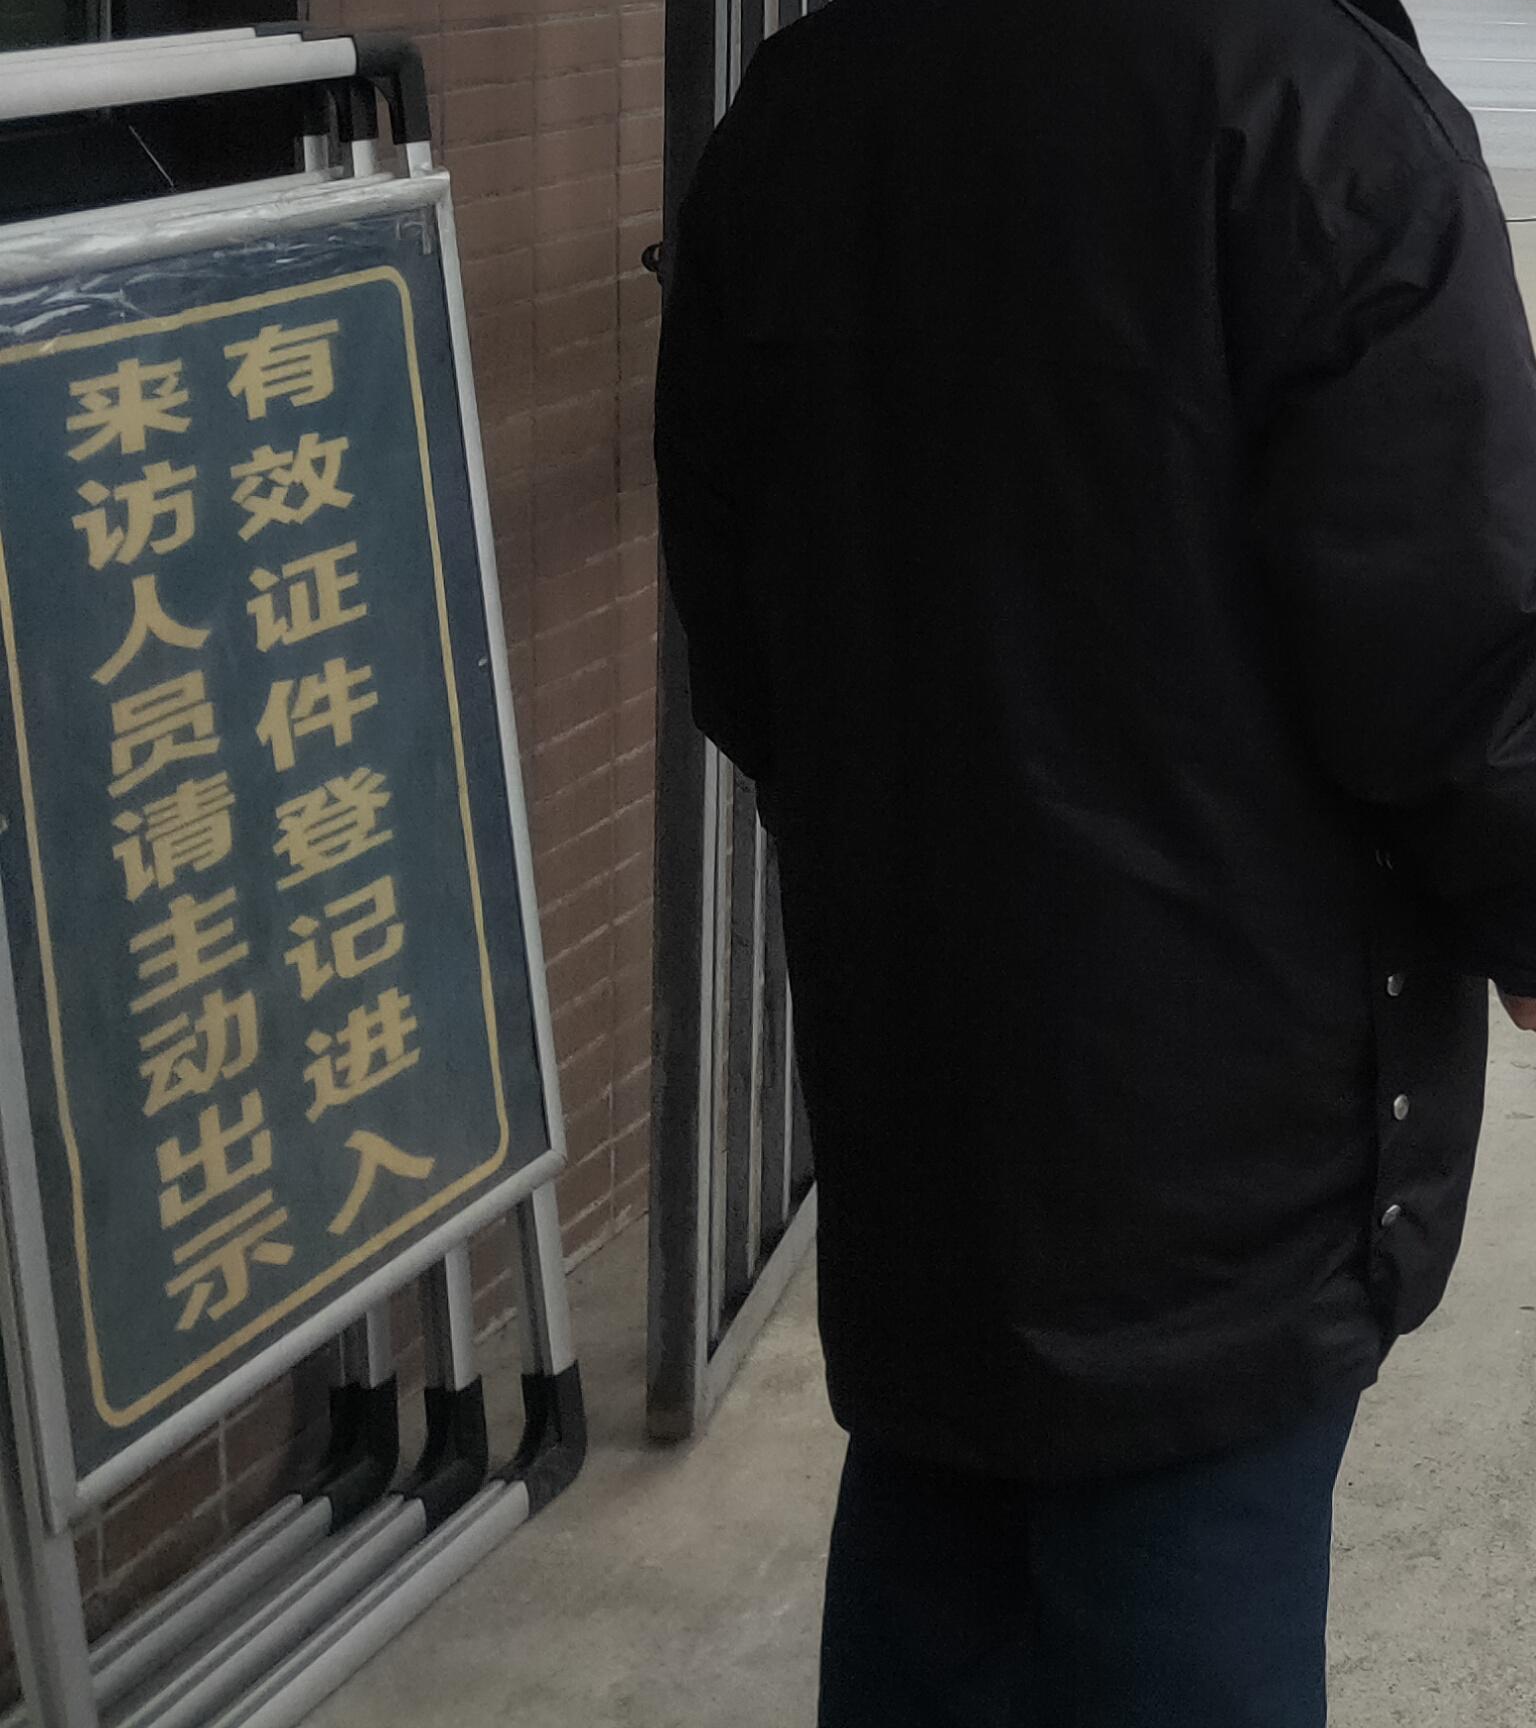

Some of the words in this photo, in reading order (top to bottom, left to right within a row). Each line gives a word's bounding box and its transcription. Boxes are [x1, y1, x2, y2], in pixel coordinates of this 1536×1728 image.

[66, 357, 295, 1333] 来访人员请主动出示
[223, 319, 436, 1236] 有效证件登记进入
